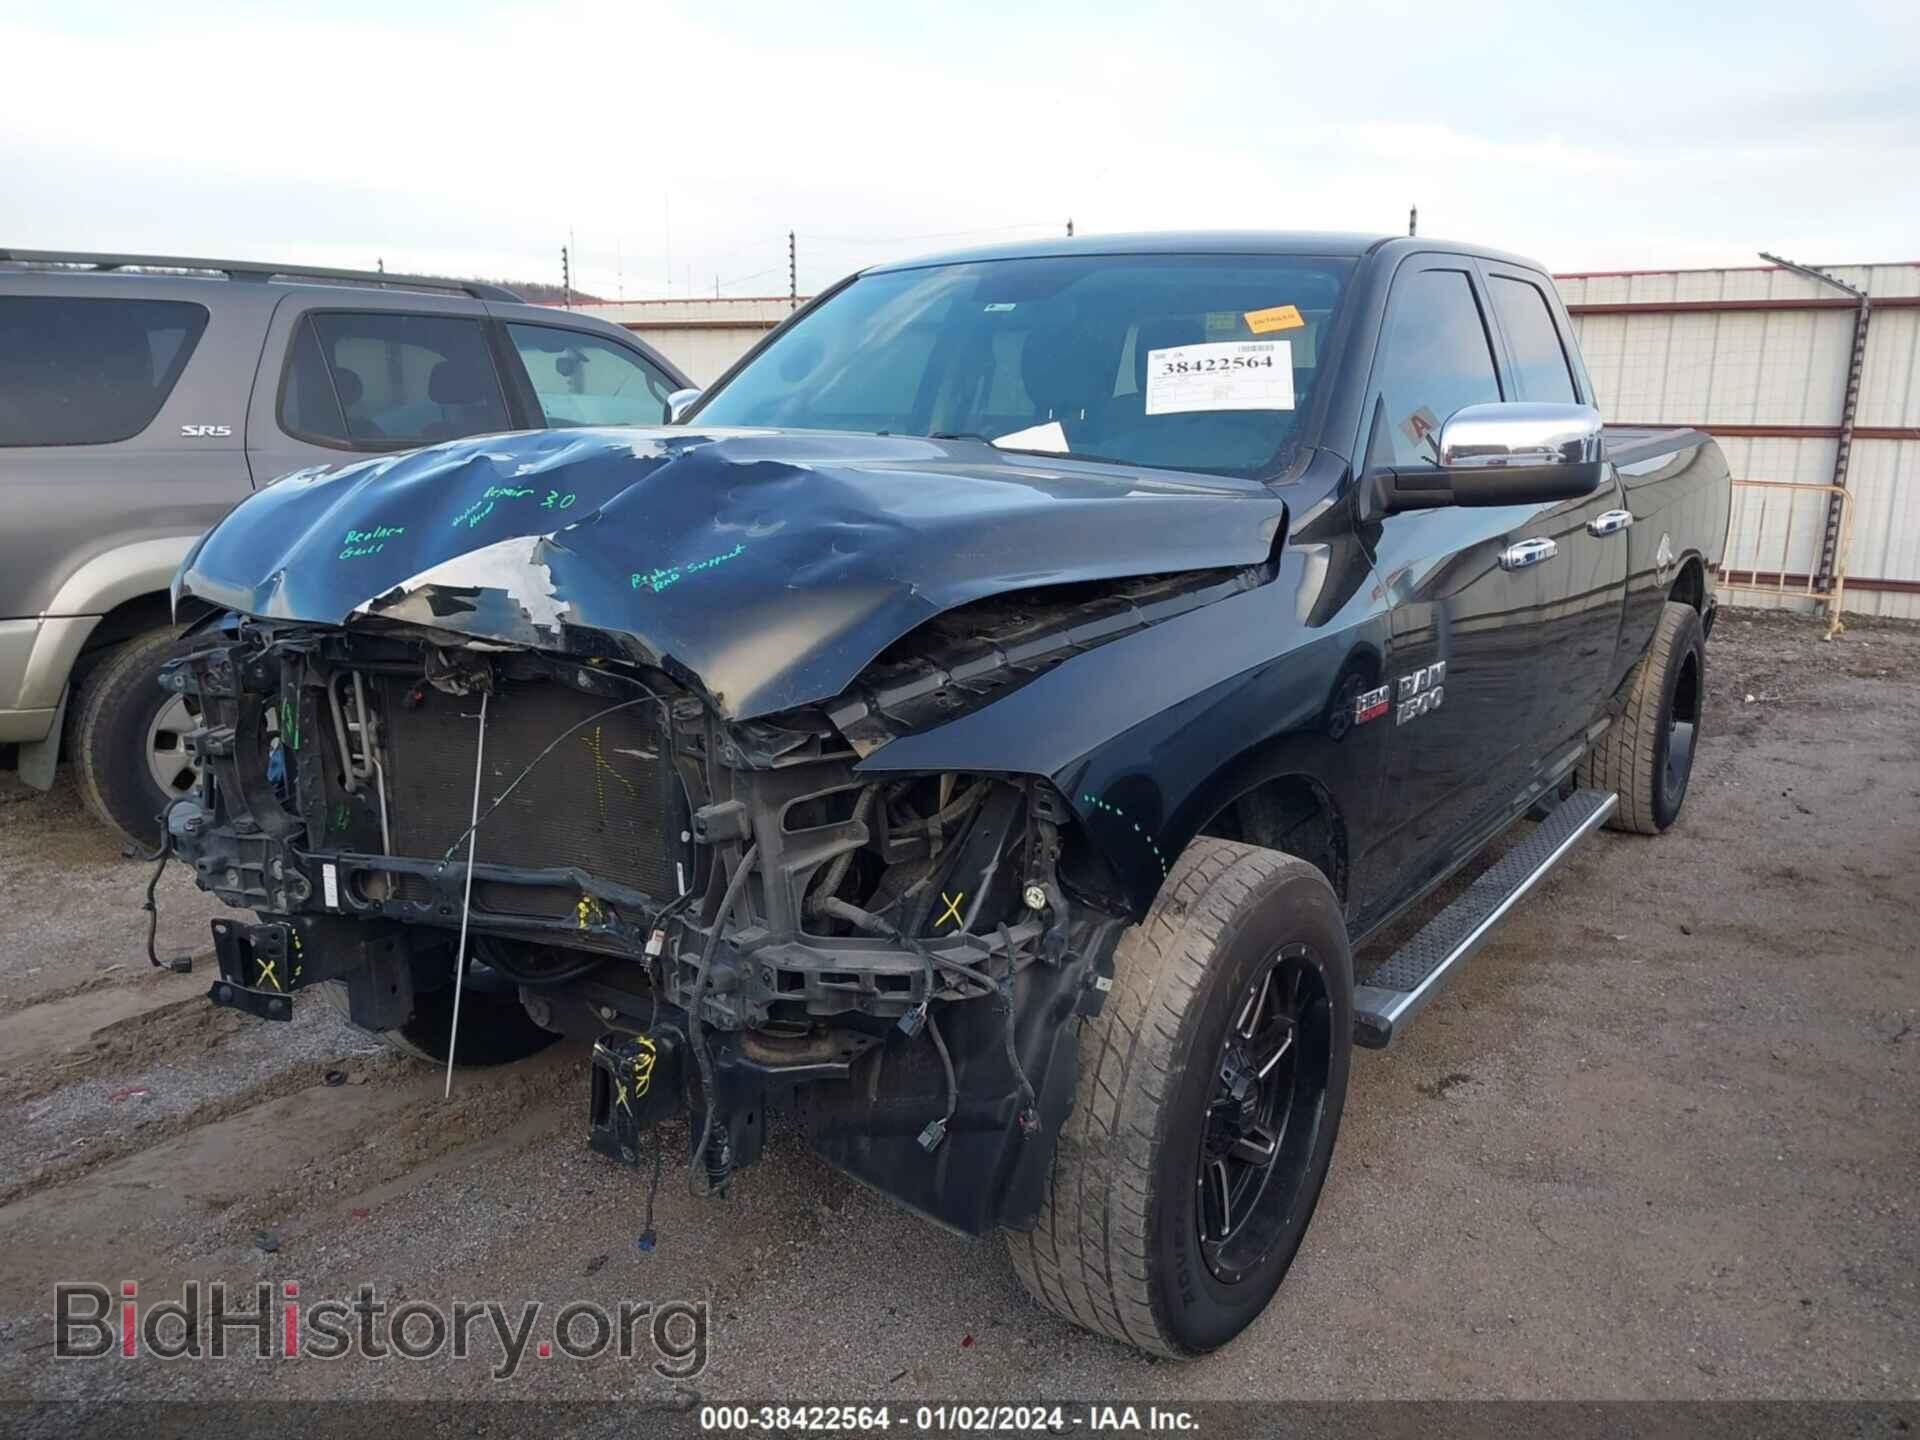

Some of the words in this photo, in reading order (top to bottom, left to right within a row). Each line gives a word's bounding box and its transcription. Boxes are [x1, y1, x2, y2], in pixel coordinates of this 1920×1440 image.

[1161, 355, 1273, 376] 38422564
[181, 424, 232, 437] SR5
[1398, 661, 1446, 699] RAM
[1396, 686, 1444, 727] 1500
